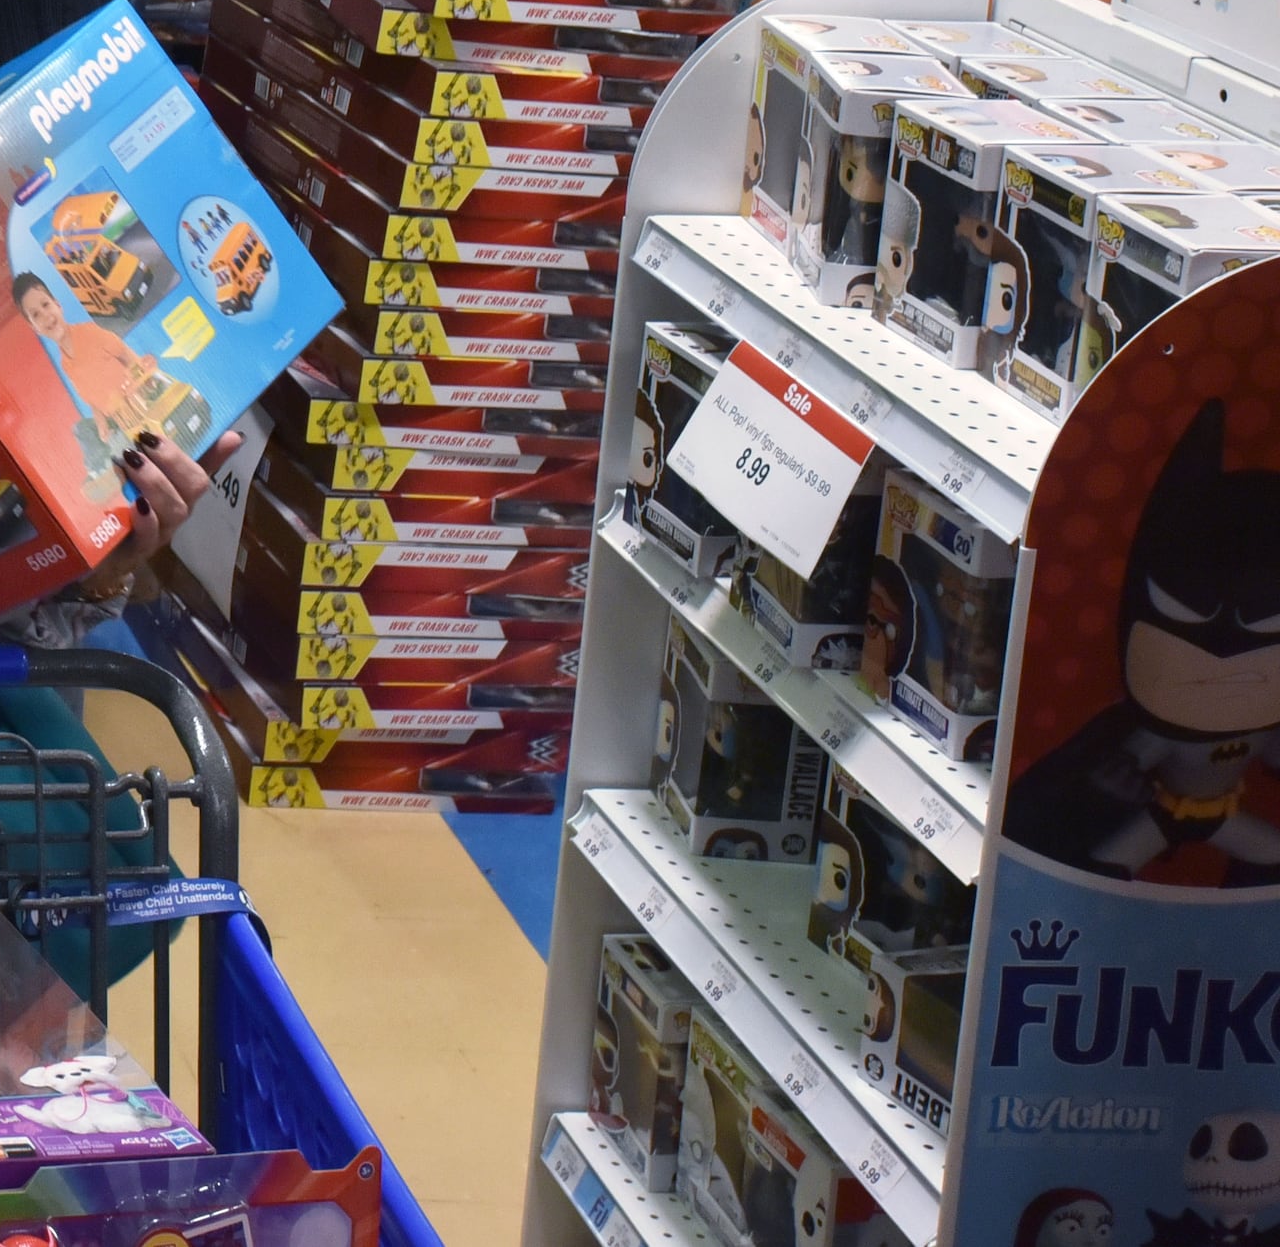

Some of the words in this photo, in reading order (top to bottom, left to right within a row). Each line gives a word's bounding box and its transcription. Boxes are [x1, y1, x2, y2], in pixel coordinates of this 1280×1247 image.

[525, 7, 551, 19] WWE
[553, 9, 587, 22] CRASH
[588, 11, 618, 24] CAGE
[28, 16, 147, 145] playmobil
[520, 106, 546, 118] WWE
[548, 108, 582, 120] CRASH
[582, 110, 610, 122] CAGE
[898, 115, 925, 146] POP!
[1005, 159, 1034, 189] POP!
[1097, 210, 1126, 244] POP!
[474, 248, 500, 259] WWE
[501, 250, 536, 262] CRASH
[536, 252, 565, 264] CAGE
[644, 253, 662, 271] 9.99
[1164, 255, 1181, 278] 286
[707, 298, 726, 317] 9.99
[465, 342, 491, 353] WWE
[492, 343, 527, 355] CRASH
[527, 345, 556, 356] CAGE
[775, 350, 795, 369] 9.99
[783, 382, 813, 417] Sale
[850, 402, 869, 425] 9.99
[400, 433, 426, 443] WWE
[428, 434, 465, 447] CRASH
[465, 437, 495, 449] CAGE
[712, 393, 730, 415] ALL
[729, 404, 749, 429] Pop!
[744, 415, 763, 442] vinyl
[762, 433, 775, 452] figs
[773, 441, 806, 479] regularly
[804, 468, 832, 498] $9.99
[735, 447, 771, 487] 8.99
[941, 473, 963, 494] 9.99
[89, 513, 122, 549] 5680
[412, 528, 438, 538] WWE
[439, 528, 475, 540] CRASH
[475, 529, 503, 541] CAGE
[622, 539, 640, 558] 9.99
[954, 534, 971, 554] 20
[26, 543, 67, 574] 5680
[670, 586, 689, 606] 9.99
[388, 620, 414, 631] WWE
[414, 621, 451, 633] CRASH
[450, 622, 480, 634] CAGE
[753, 663, 774, 684] 9.99
[895, 681, 922, 714] ULTIMATE
[820, 729, 842, 751] 9.99
[340, 795, 367, 805] WWE
[367, 796, 404, 807] CRASH
[404, 797, 432, 809] CAGE
[913, 816, 936, 840] 9.99
[582, 838, 601, 858] 9.99
[114, 886, 150, 900] Fasten
[151, 882, 180, 895] Child
[181, 881, 226, 894] Securely
[113, 899, 144, 912] Leave
[144, 895, 174, 908] Child
[175, 892, 235, 905] Unattended
[637, 901, 656, 922] 9.99
[704, 979, 725, 1002] 9.99
[990, 962, 1280, 1073] FUNK
[783, 1072, 805, 1097] 9.99
[994, 1095, 1163, 1134] ReAction
[121, 1137, 148, 1146] AGES
[149, 1135, 163, 1144] 4+
[858, 1159, 881, 1185] 9.99
